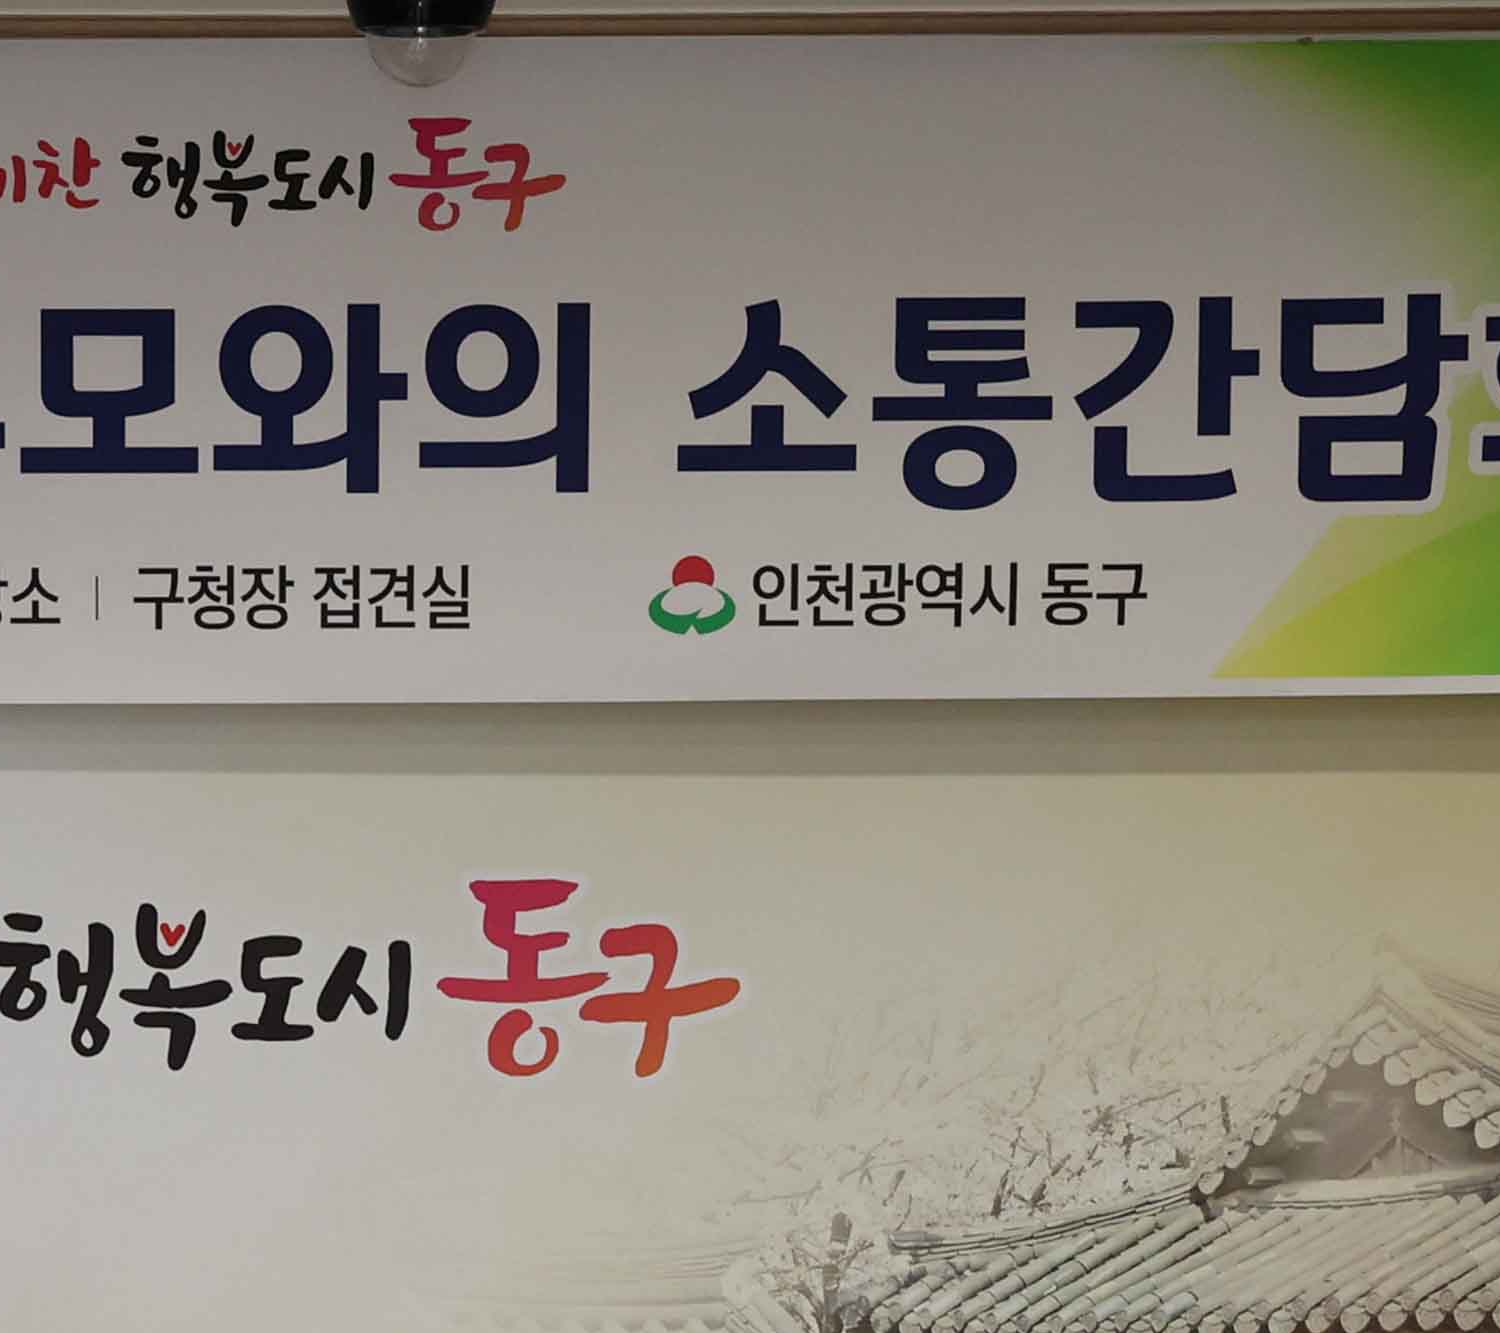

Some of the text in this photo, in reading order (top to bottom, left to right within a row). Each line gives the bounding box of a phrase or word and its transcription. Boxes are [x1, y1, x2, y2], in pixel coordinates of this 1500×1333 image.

[120, 130, 375, 228] 행복도시
[388, 117, 567, 232] 동구
[132, 564, 295, 631] 구청장
[312, 564, 472, 631] 접견실
[751, 561, 1149, 629] 인천광역시 동구
[435, 877, 742, 1079] 동구
